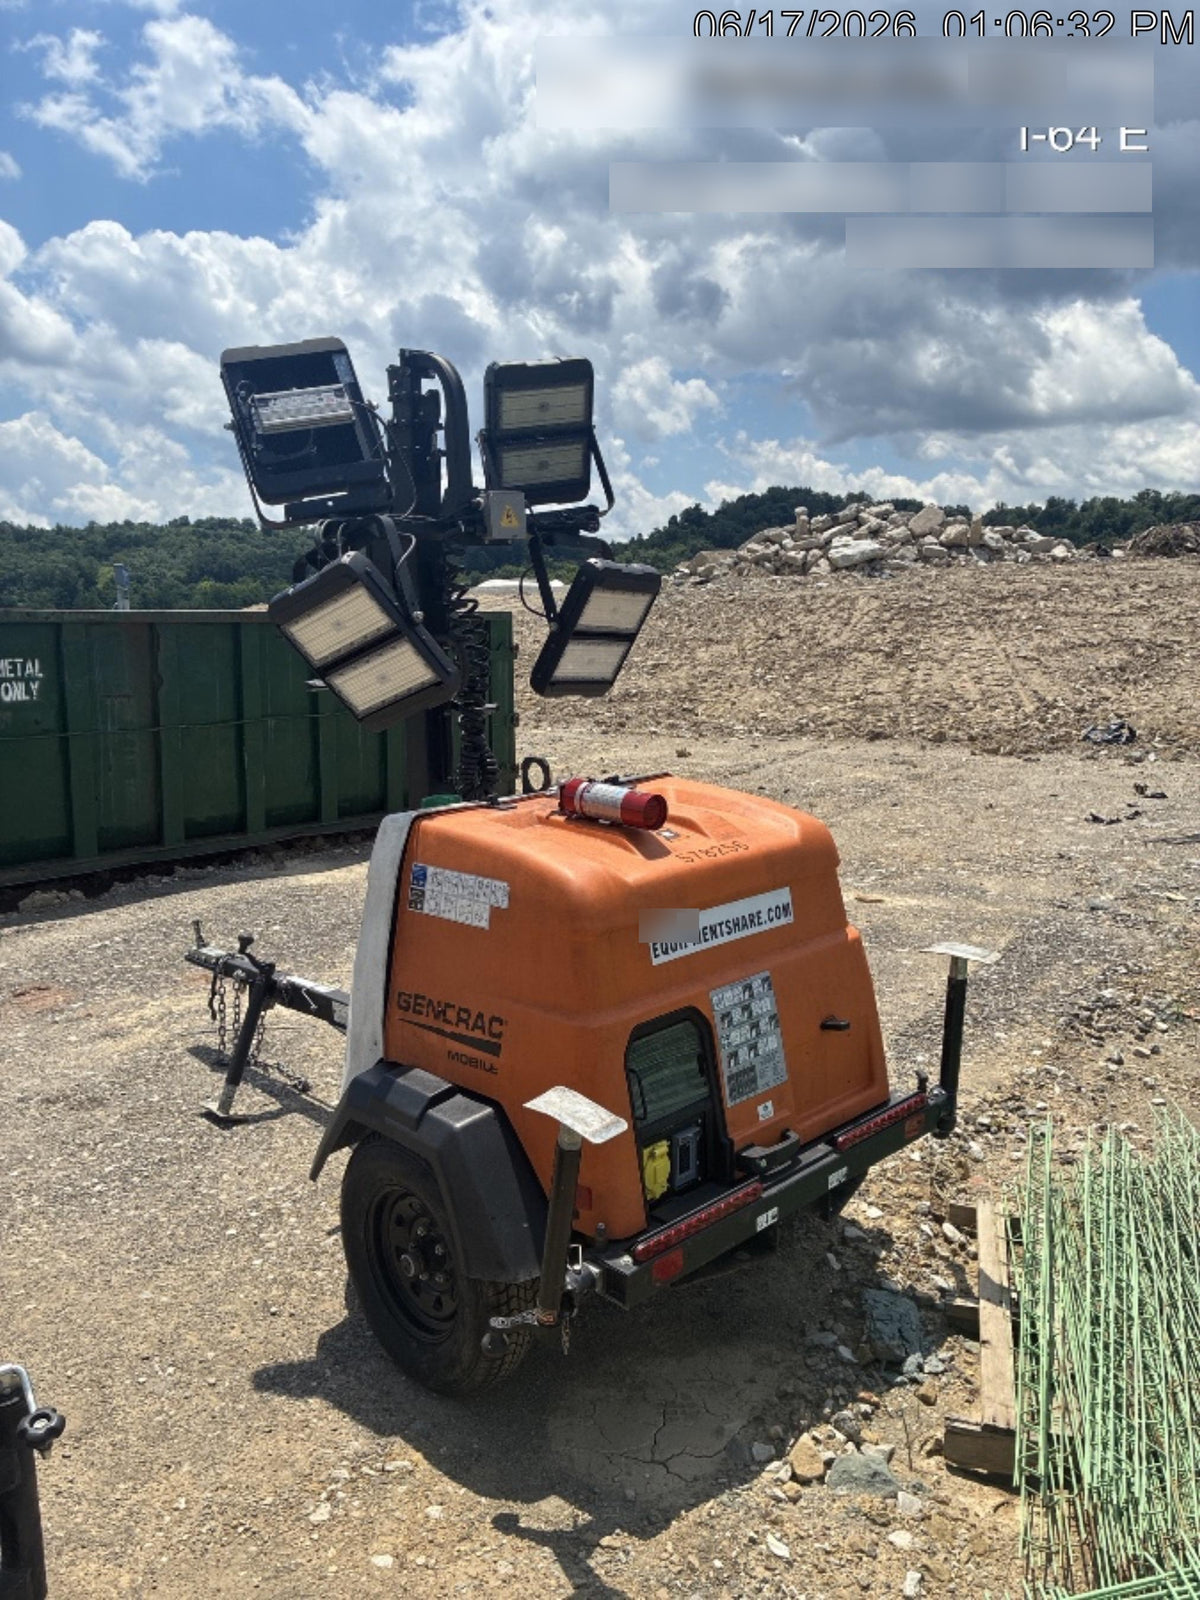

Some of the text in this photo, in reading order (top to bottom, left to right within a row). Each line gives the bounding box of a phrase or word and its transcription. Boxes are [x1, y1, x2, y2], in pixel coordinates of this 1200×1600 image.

[0, 680, 40, 702] ONLY
[652, 902, 792, 959] EQUENTSHARE.COM
[397, 991, 503, 1039] GENERAC
[447, 1050, 499, 1074] MOBILE
